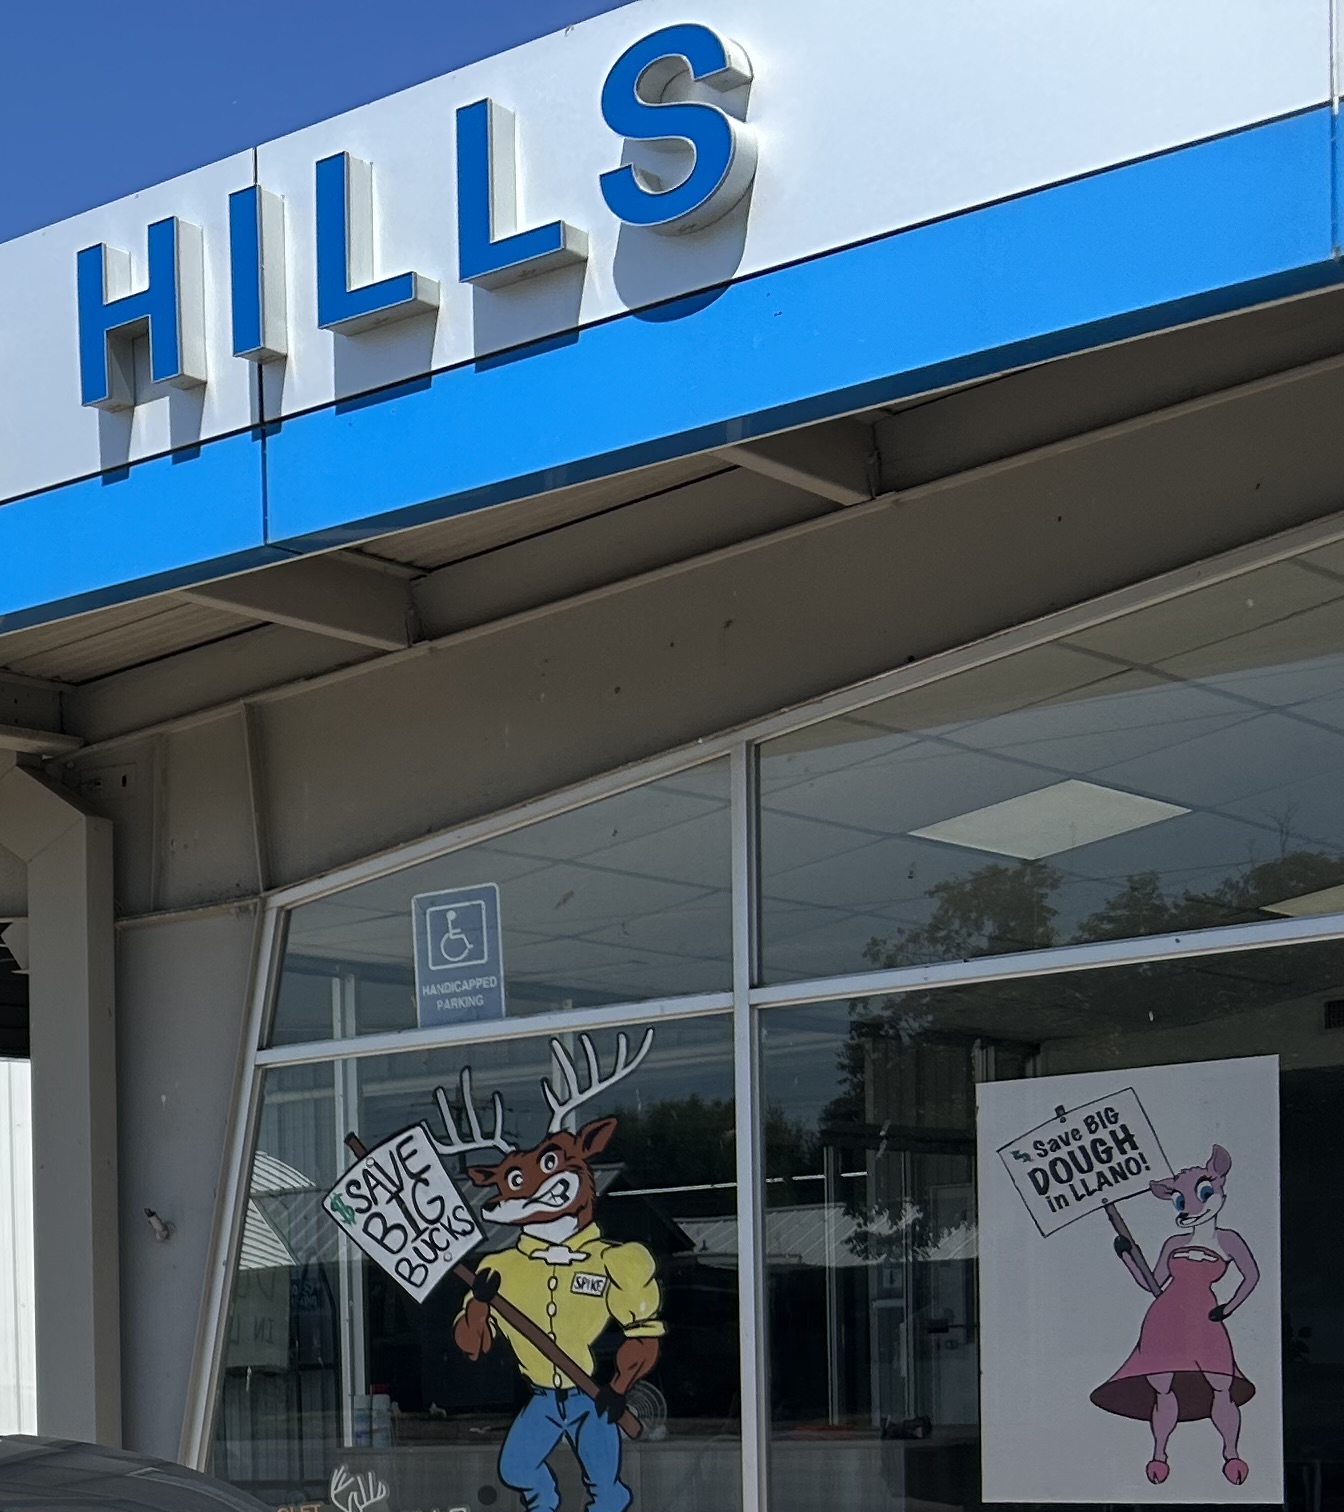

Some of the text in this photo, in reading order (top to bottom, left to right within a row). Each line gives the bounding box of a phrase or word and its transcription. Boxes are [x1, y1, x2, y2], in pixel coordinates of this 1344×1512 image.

[77, 23, 756, 411] HILLS
[422, 976, 498, 996] HANDICAPPED
[437, 995, 484, 1010] PARKING
[1027, 1124, 1139, 1196] DOUGH
[1033, 1128, 1082, 1158] Save
[1083, 1107, 1119, 1134] BIG
[345, 1135, 431, 1214] SAVE
[1045, 1152, 1151, 1213] in LLANO!
[362, 1177, 445, 1255] BIG
[395, 1205, 475, 1288] BUCKS
[574, 1276, 603, 1292] SPIKE
